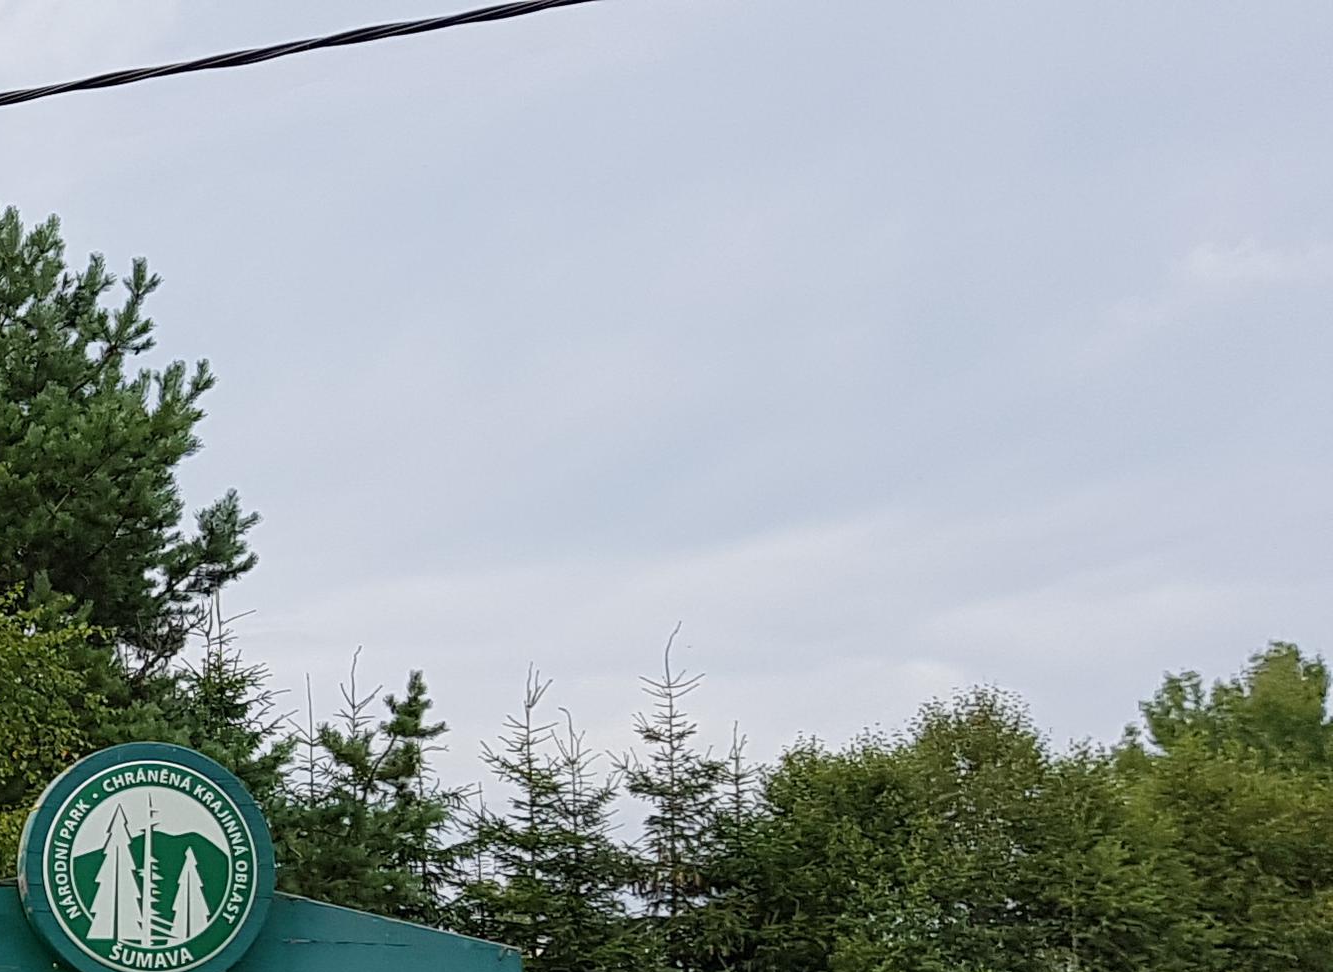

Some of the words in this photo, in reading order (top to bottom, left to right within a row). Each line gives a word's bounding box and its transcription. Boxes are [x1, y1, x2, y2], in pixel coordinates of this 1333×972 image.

[102, 767, 191, 793] CHRÁNĚNÁ
[59, 798, 91, 840] PARK
[192, 784, 249, 857] KRAJINNÁ
[53, 840, 82, 920] NÁRODNÍ
[222, 859, 249, 924] OBLAST
[108, 940, 194, 970] ŠUMAVA
